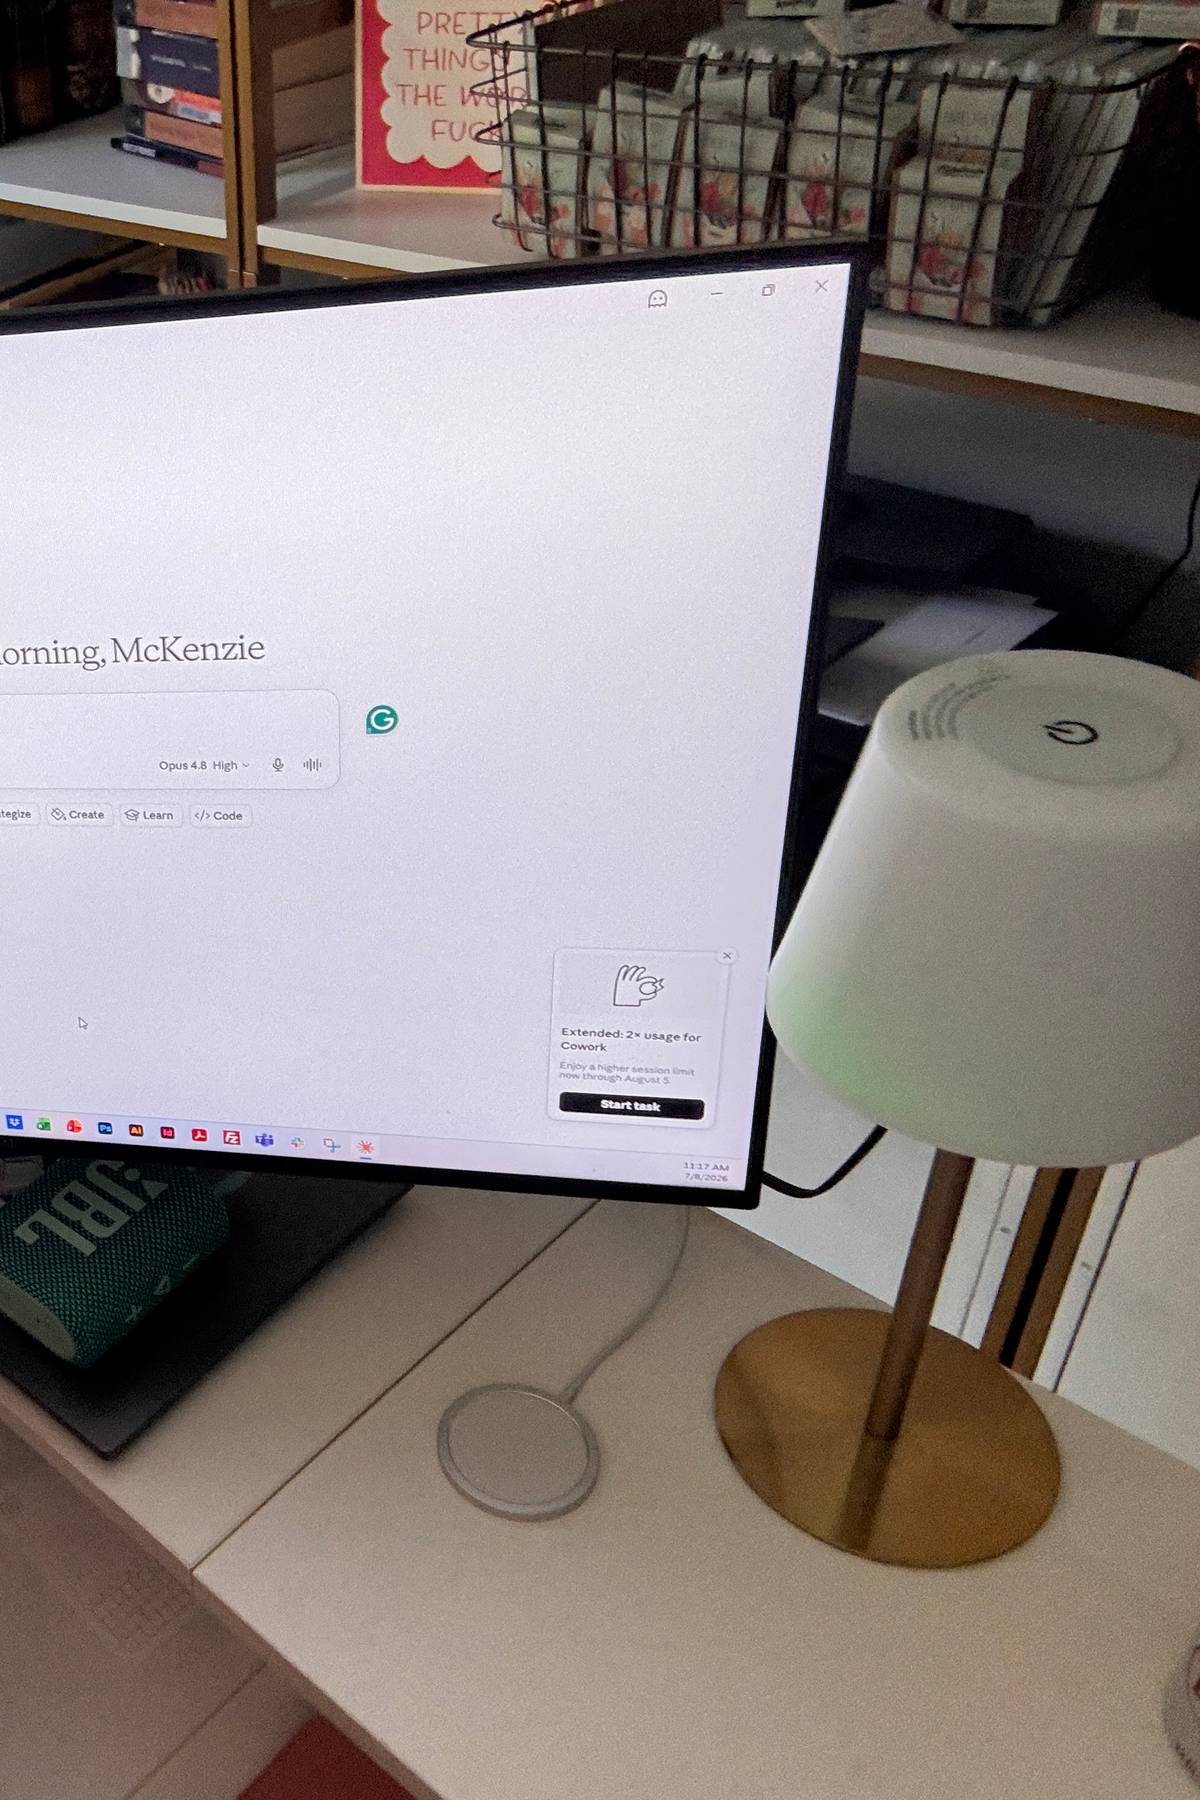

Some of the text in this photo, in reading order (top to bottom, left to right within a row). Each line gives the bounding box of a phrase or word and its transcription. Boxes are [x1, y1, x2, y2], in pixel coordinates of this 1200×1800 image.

[418, 11, 529, 35] PRETT
[396, 84, 446, 107] THE
[110, 635, 266, 664] McKenzie
[159, 760, 188, 774] Opus
[190, 760, 207, 771] 4.8
[212, 759, 238, 774] High
[68, 810, 105, 820] Create
[142, 810, 174, 821] Learn
[213, 810, 243, 821] Code
[561, 1027, 623, 1039] Extended:
[644, 1032, 681, 1043] usage
[683, 1033, 703, 1042] for
[561, 1041, 607, 1052] Cowork
[560, 1062, 587, 1072] Enjoy
[597, 1063, 629, 1074] higher
[632, 1065, 670, 1075] session
[673, 1067, 695, 1076] limit
[582, 1072, 622, 1084] through
[624, 1075, 661, 1085] August
[600, 1100, 661, 1112] Start task
[711, 1163, 730, 1172] AM
[13, 1159, 147, 1257] JBL
